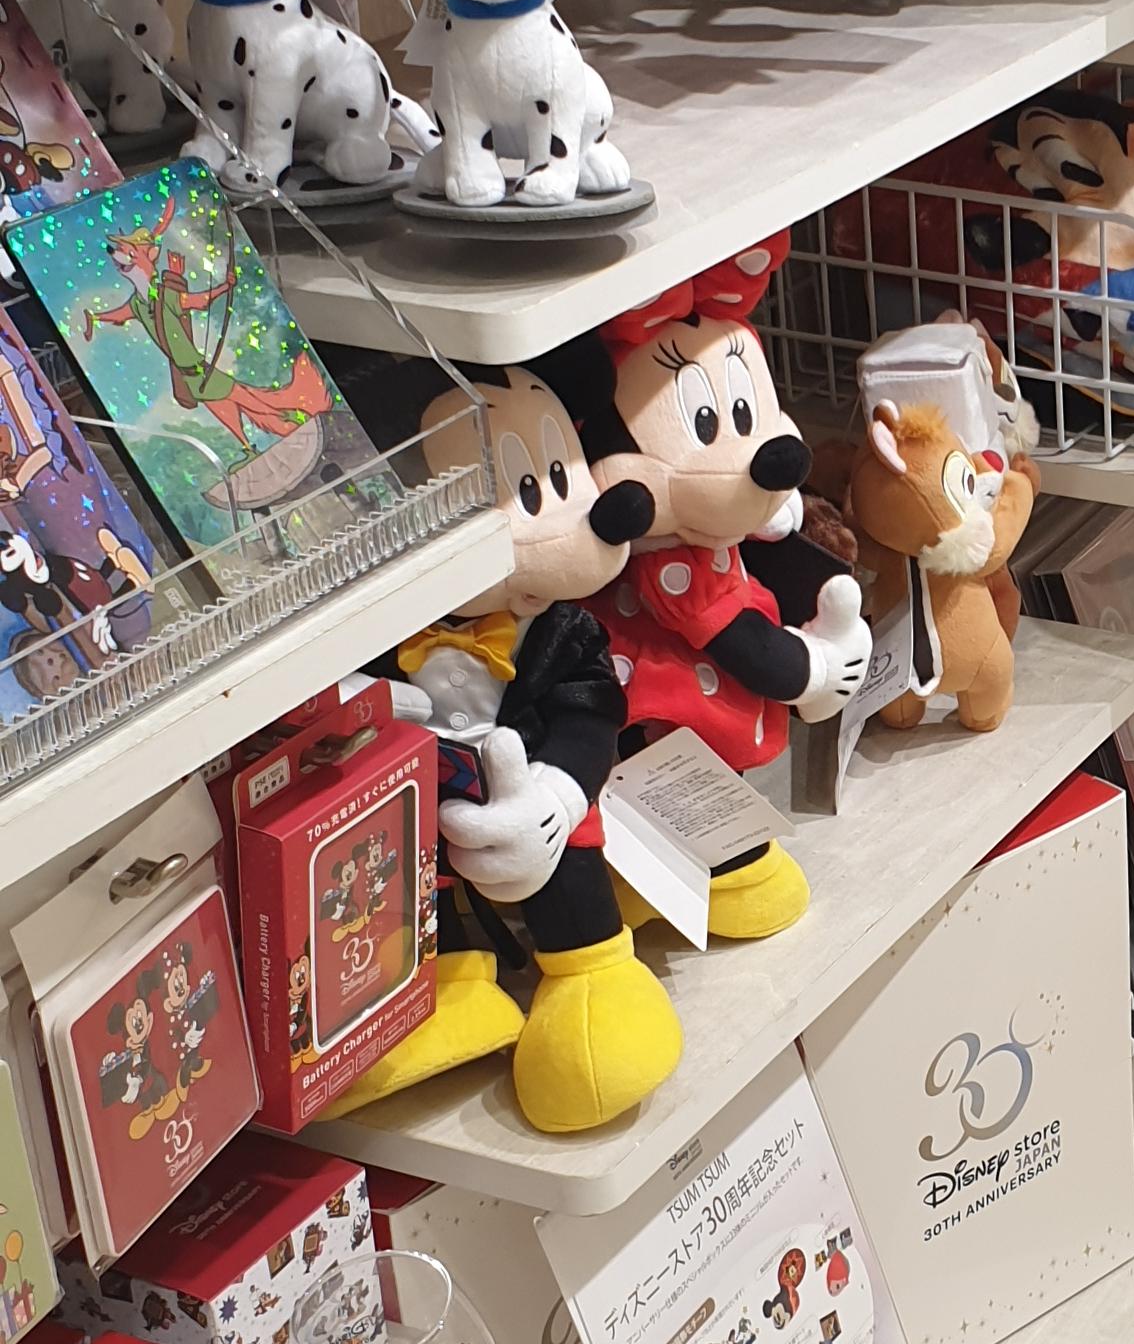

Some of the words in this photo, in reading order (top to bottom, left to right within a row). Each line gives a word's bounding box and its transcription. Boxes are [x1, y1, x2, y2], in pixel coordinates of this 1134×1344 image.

[302, 1051, 342, 1089] Battery
[343, 1015, 384, 1056] Charger
[919, 1032, 1033, 1162] 30
[163, 1120, 193, 1164] 30
[917, 1148, 1010, 1209] Disney
[1013, 1119, 1061, 1157] store
[1015, 1136, 1062, 1174] JAPAN
[604, 1118, 806, 1341] ディズニーストア30周年記念セット
[665, 1187, 700, 1225] TSUM
[698, 1152, 731, 1193] TSUM
[923, 1211, 962, 1242] 30TH
[966, 1151, 1062, 1219] ANNIVERSARY
